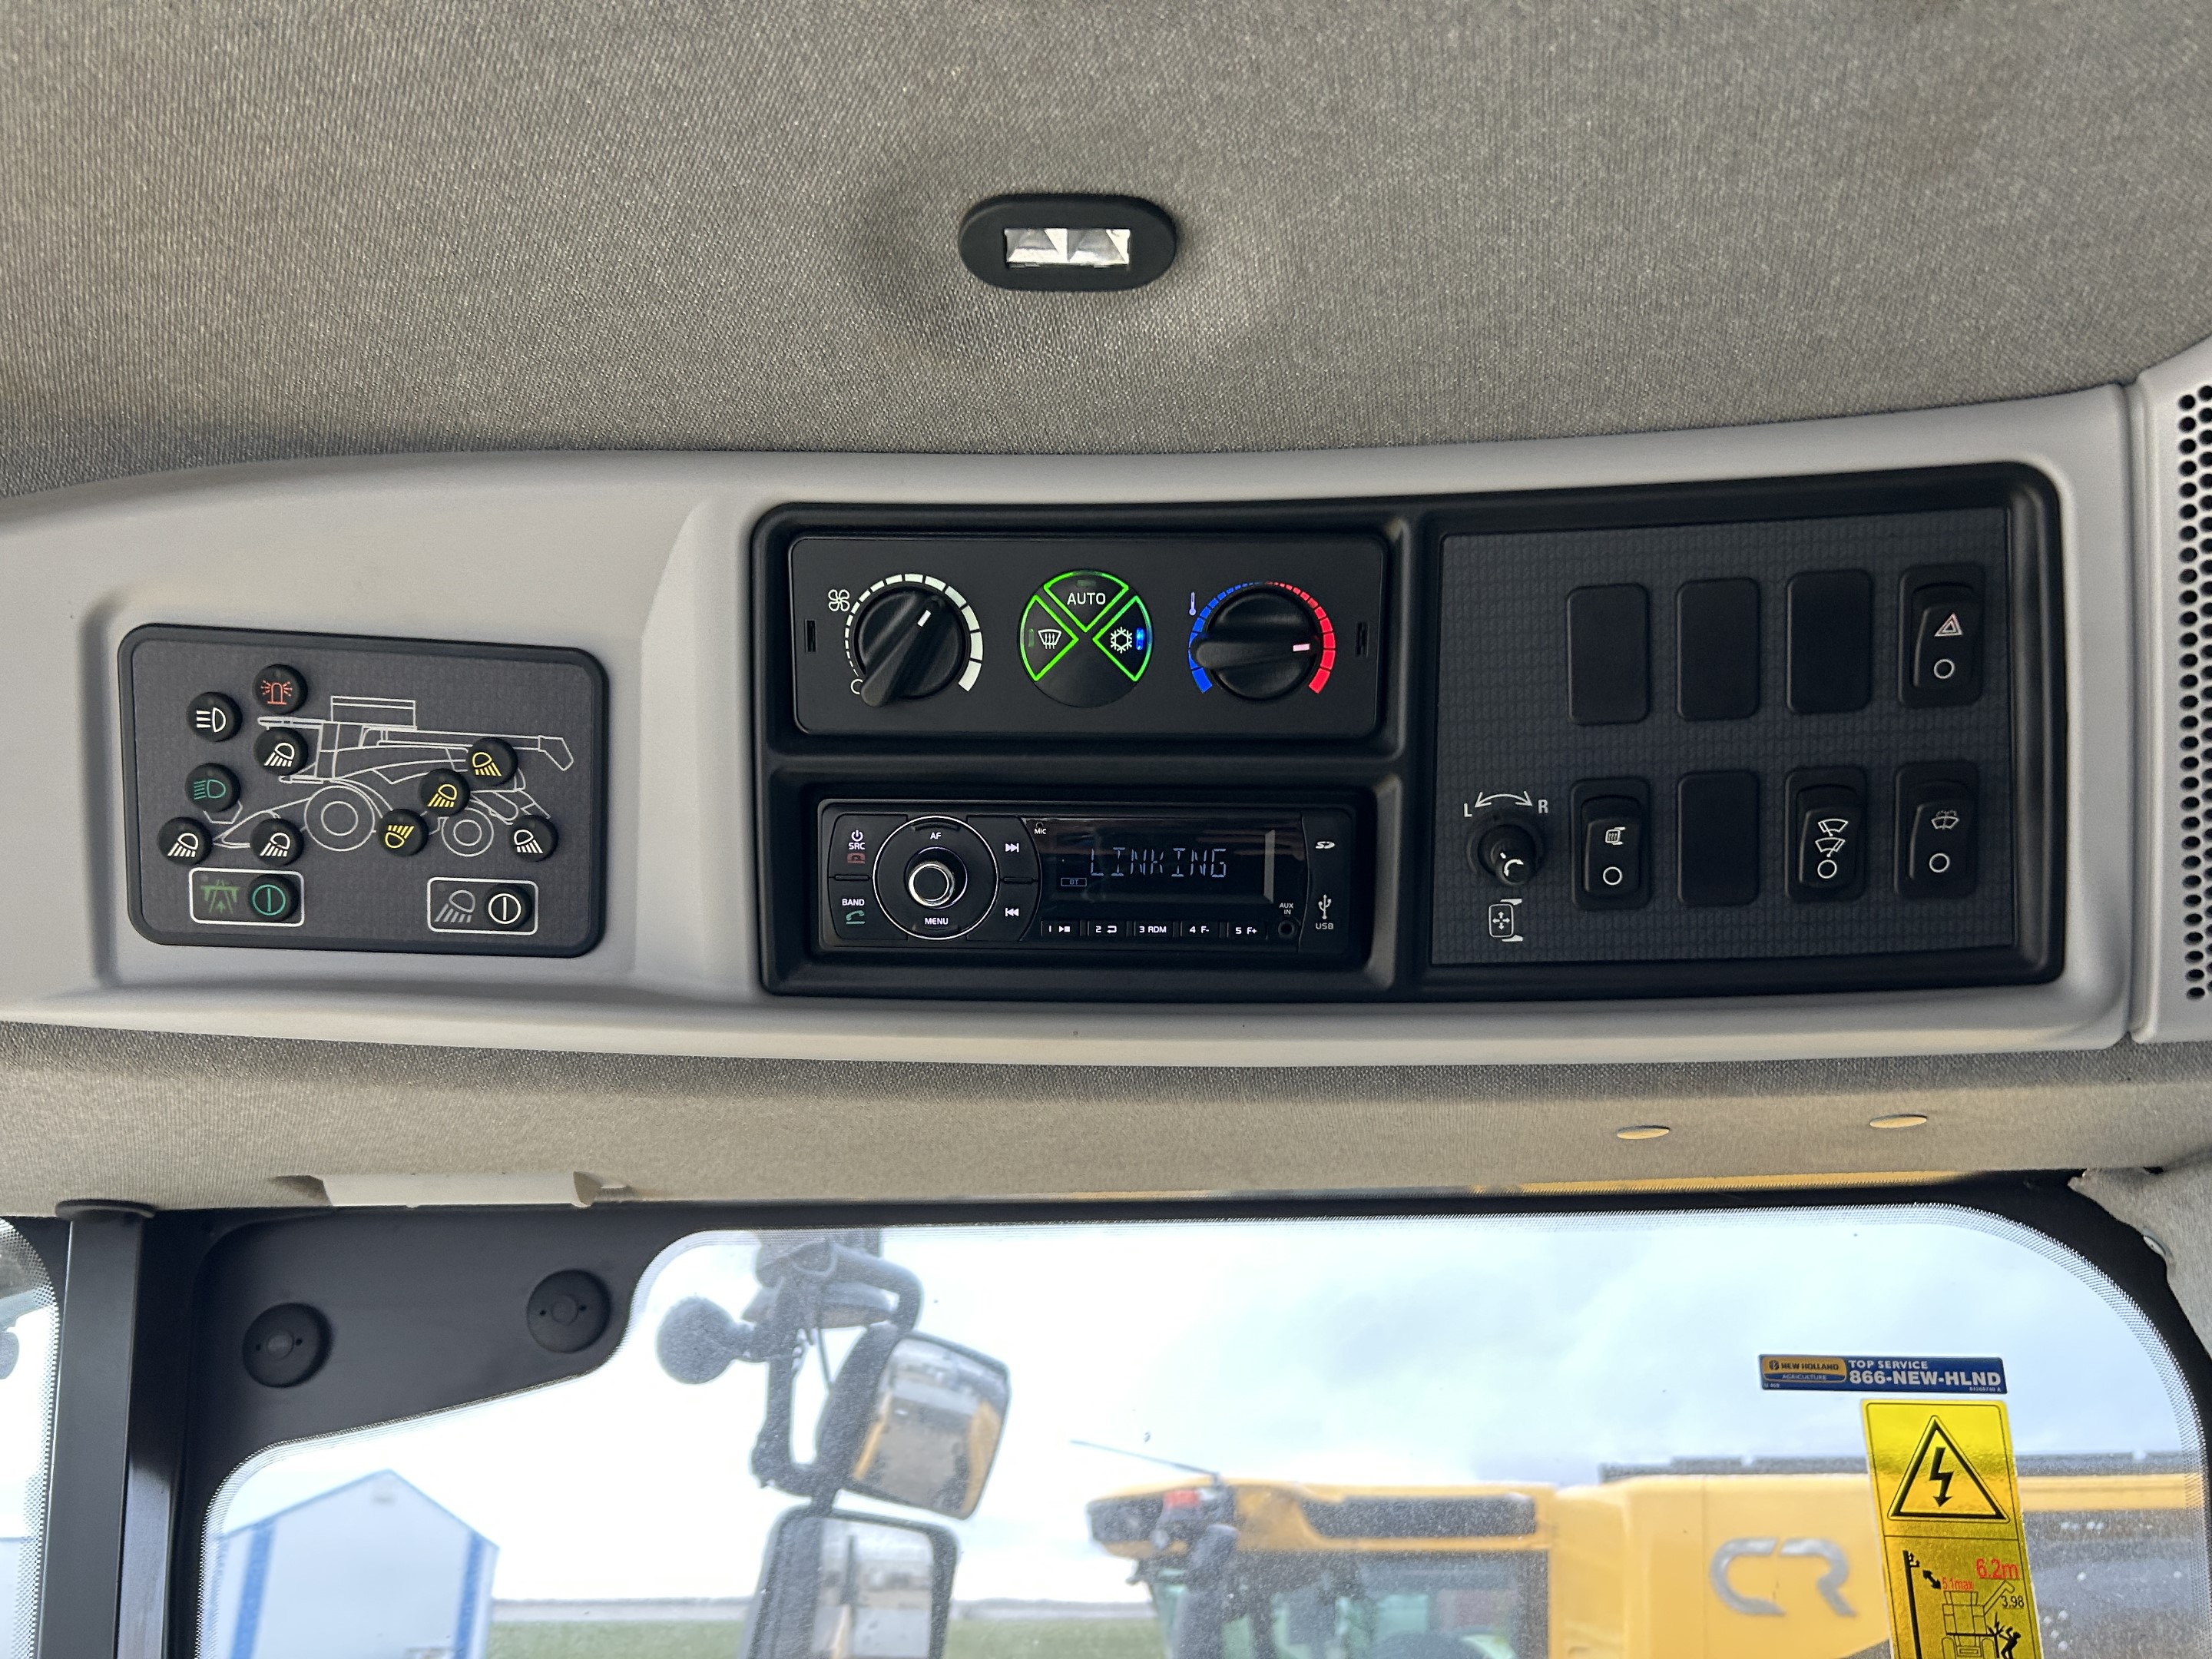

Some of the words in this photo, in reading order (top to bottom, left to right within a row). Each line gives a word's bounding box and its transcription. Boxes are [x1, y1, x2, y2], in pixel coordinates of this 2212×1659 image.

[1067, 592, 1106, 605] AUTO
[1463, 803, 1472, 817] L
[1538, 799, 1548, 814] R
[929, 832, 942, 840] AF
[848, 842, 866, 850] SRC
[1090, 846, 1227, 878] LINKING
[1848, 1359, 1874, 1369] TOP
[1878, 1360, 1928, 1369] SERVICE
[1849, 1370, 2001, 1386] 866-NEW-HLND
[1976, 1558, 2019, 1580] 6.2m
[1710, 1538, 1857, 1617] CR
[1942, 1577, 1973, 1591] 5.1max
[2001, 1595, 2024, 1608] 3.98
